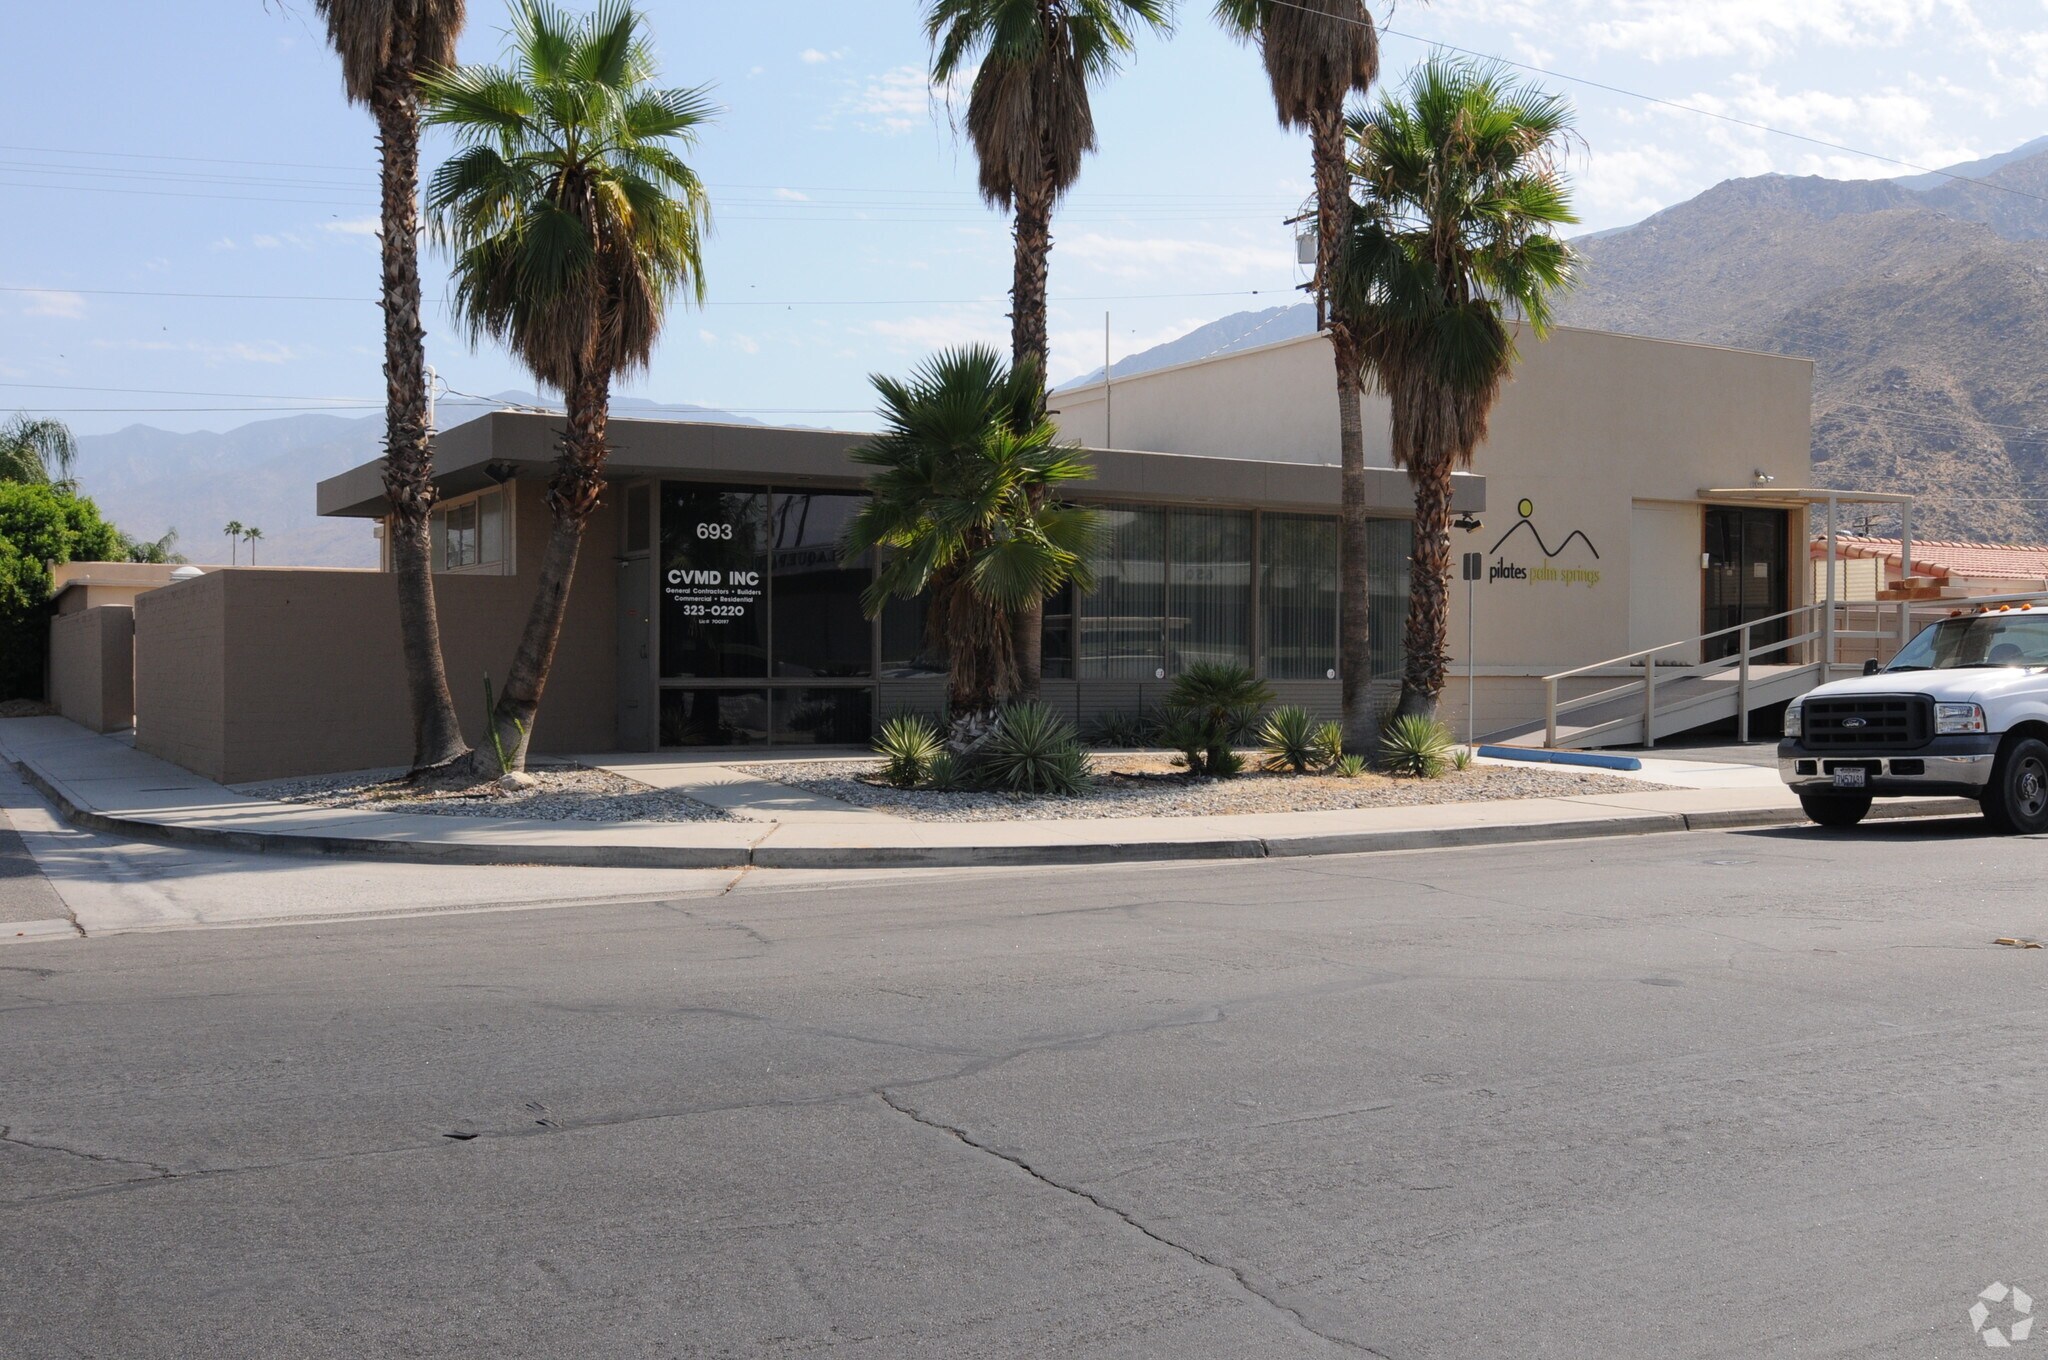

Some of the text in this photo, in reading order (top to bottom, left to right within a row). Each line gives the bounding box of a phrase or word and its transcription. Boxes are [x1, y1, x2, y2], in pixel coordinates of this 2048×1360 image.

[697, 523, 733, 540] 693
[668, 570, 759, 586] CVMD INC
[1490, 557, 1600, 588] pilates palm springs
[692, 587, 729, 595] Contractors
[683, 605, 745, 617] 323-0220
